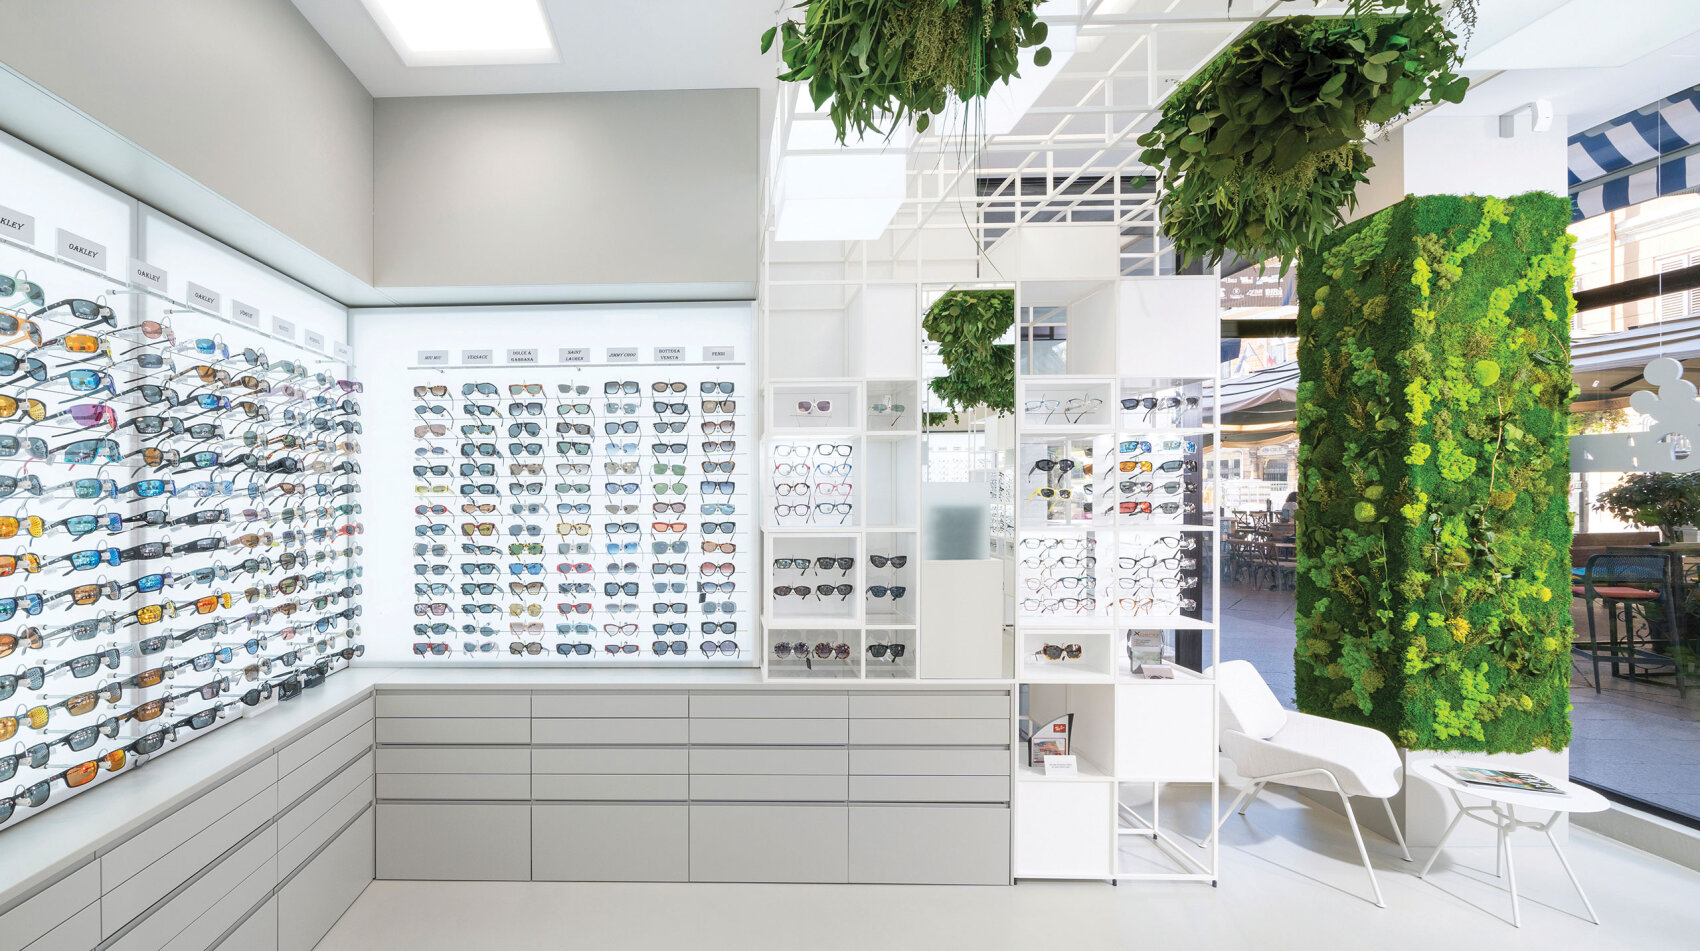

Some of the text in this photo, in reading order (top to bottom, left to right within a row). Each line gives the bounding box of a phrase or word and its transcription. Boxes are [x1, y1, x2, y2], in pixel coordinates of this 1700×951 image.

[0, 217, 25, 231] KLEY
[68, 243, 99, 259] OAKLEY
[137, 268, 161, 283] OAKLEY
[194, 292, 215, 304] OAKLEY
